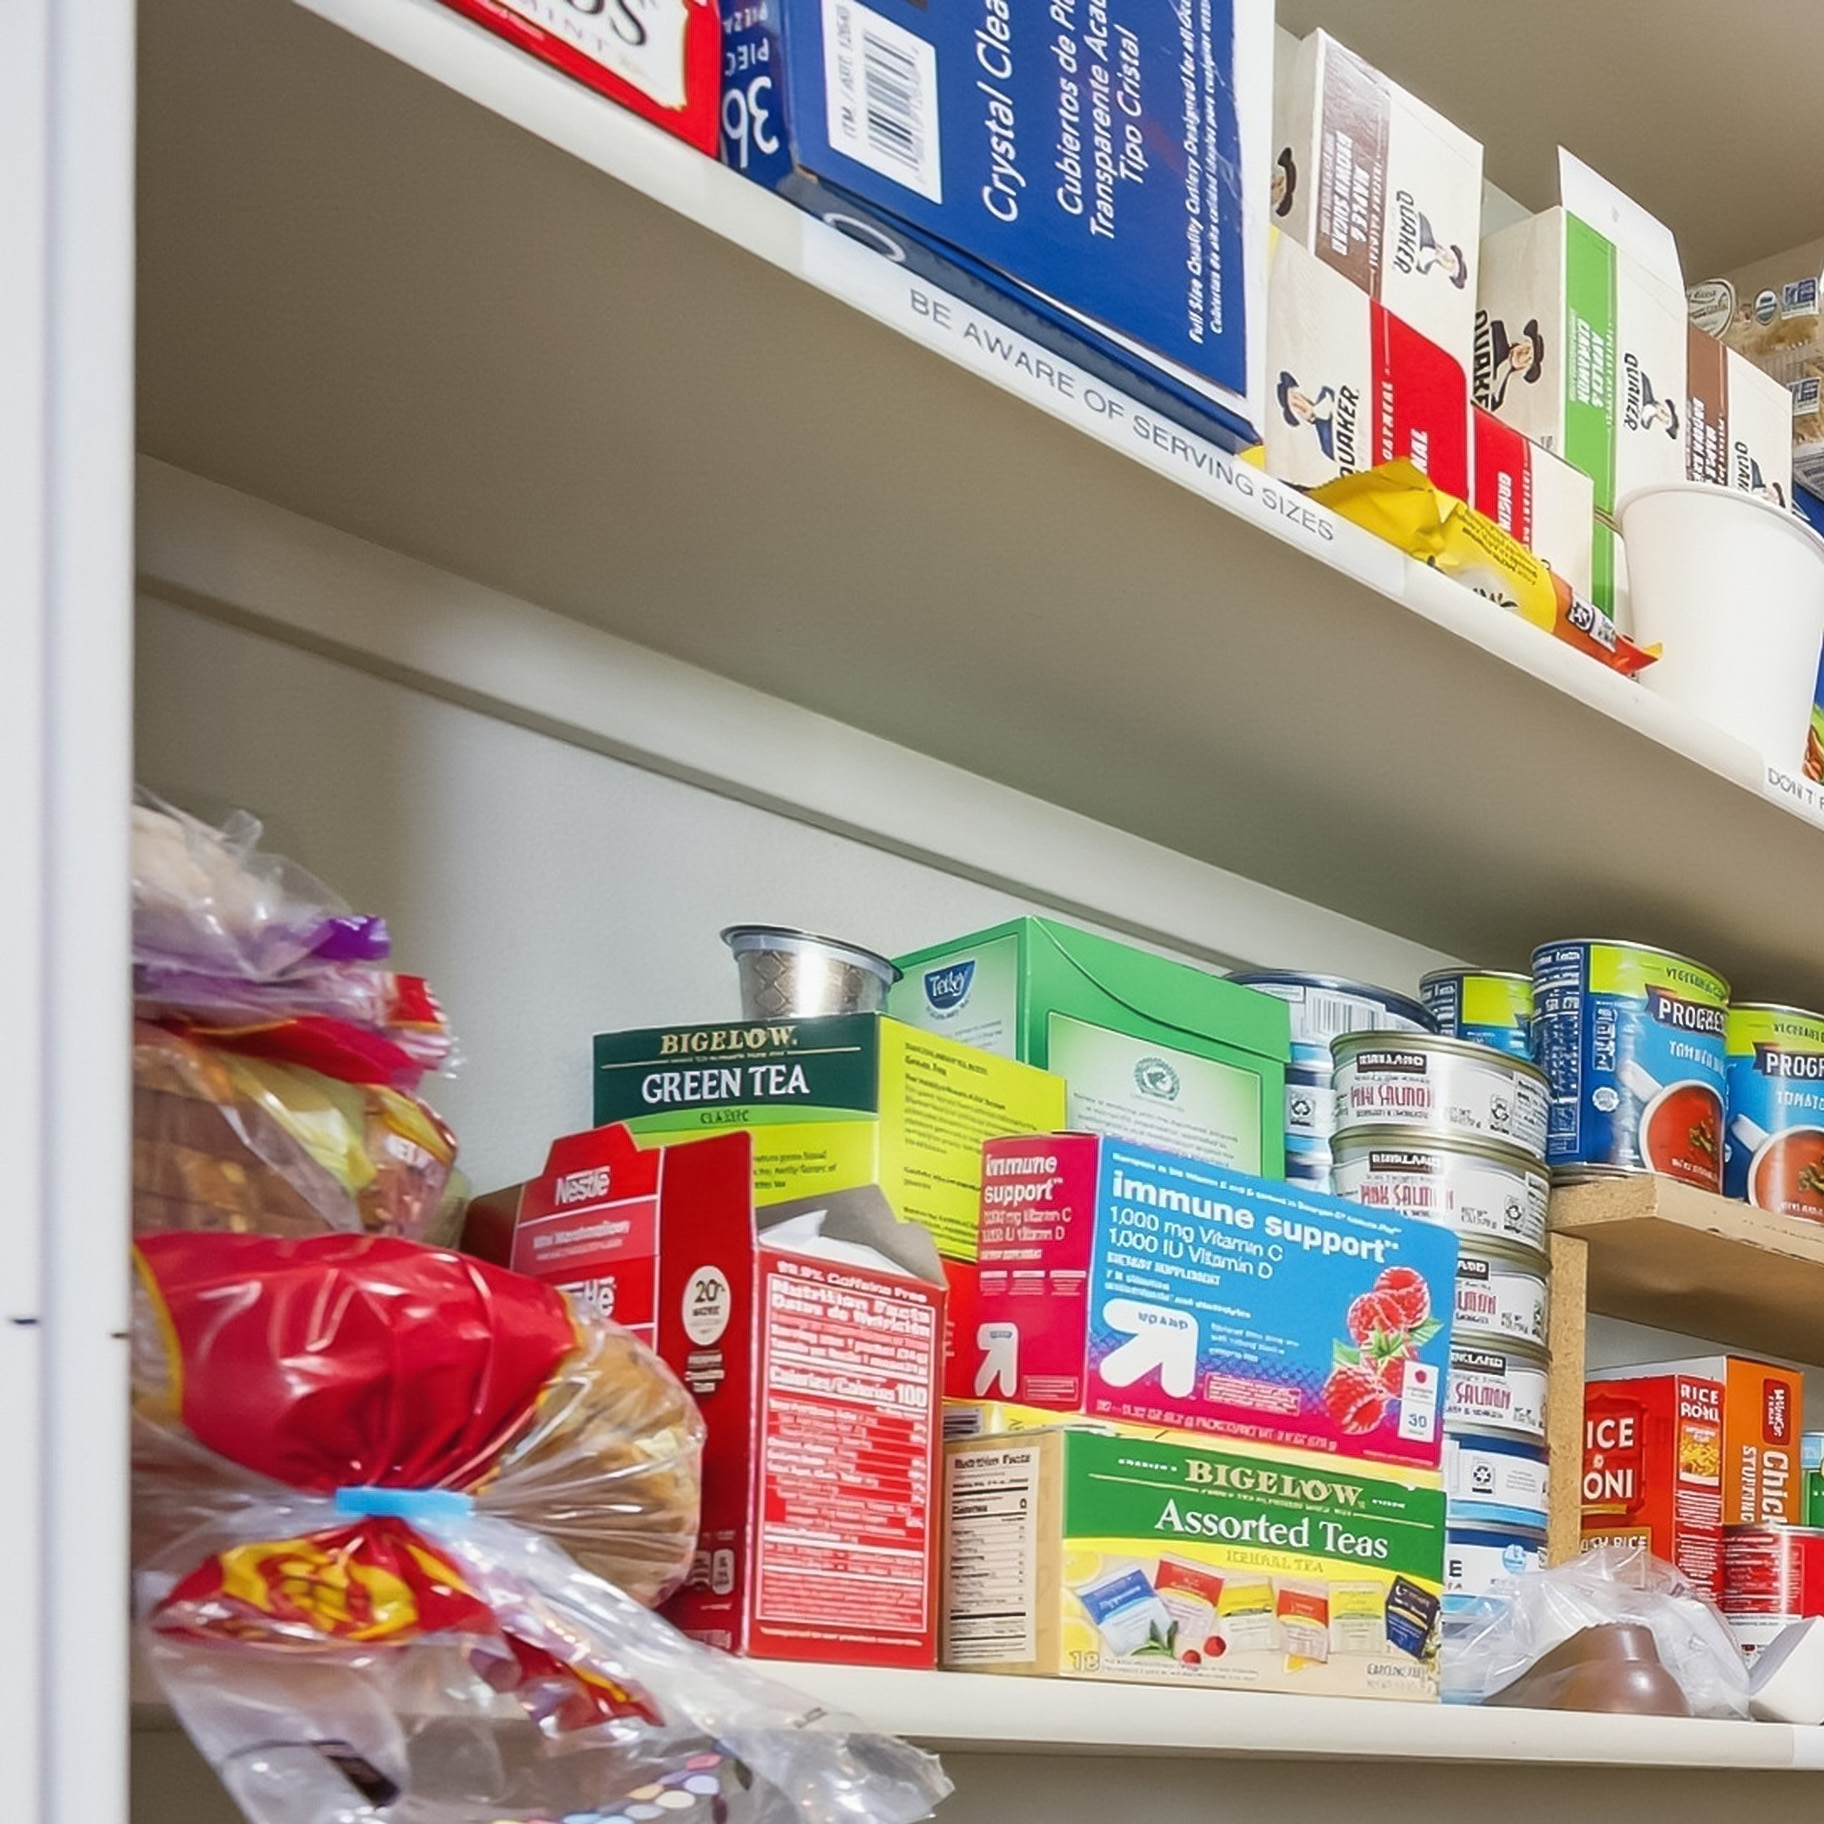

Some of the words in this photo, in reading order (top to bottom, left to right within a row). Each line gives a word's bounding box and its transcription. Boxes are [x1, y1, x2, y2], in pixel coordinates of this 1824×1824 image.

[975, 0, 1012, 80] Clea
[1051, 34, 1077, 73] de
[1114, 23, 1142, 117] Cristal
[977, 81, 1026, 222] Crystal
[1056, 78, 1084, 215] Cubiertos
[1084, 64, 1118, 239] Transparente
[1119, 124, 1149, 184] Tipo
[1393, 190, 1416, 274] QUAKER
[909, 288, 952, 329] BE
[964, 322, 1075, 399] AWARE
[1084, 386, 1125, 422] OF
[1134, 412, 1254, 499] SERVING
[1261, 486, 1335, 542] SIZES
[1767, 766, 1817, 806] DON'T
[641, 1065, 743, 1104] GREEN
[748, 1065, 810, 1097] TEA
[985, 1154, 1058, 1179] immune
[1111, 1172, 1258, 1231] immune
[1108, 1230, 1159, 1256] 1,000
[1162, 1237, 1184, 1260] IU
[1189, 1243, 1256, 1277] Vitamin
[1258, 1261, 1273, 1279] D
[1109, 1205, 1159, 1236] 1,000
[1163, 1220, 1196, 1246] mg
[1200, 1225, 1264, 1257] Vitamin
[1268, 1245, 1284, 1262] C
[1680, 1384, 1719, 1405] RICE
[1586, 1417, 1634, 1449] ICE
[1185, 1459, 1363, 1509] BIGELOW
[1583, 1468, 1634, 1500] ONI
[1156, 1498, 1312, 1546] Assorted
[1320, 1521, 1389, 1559] Teas
